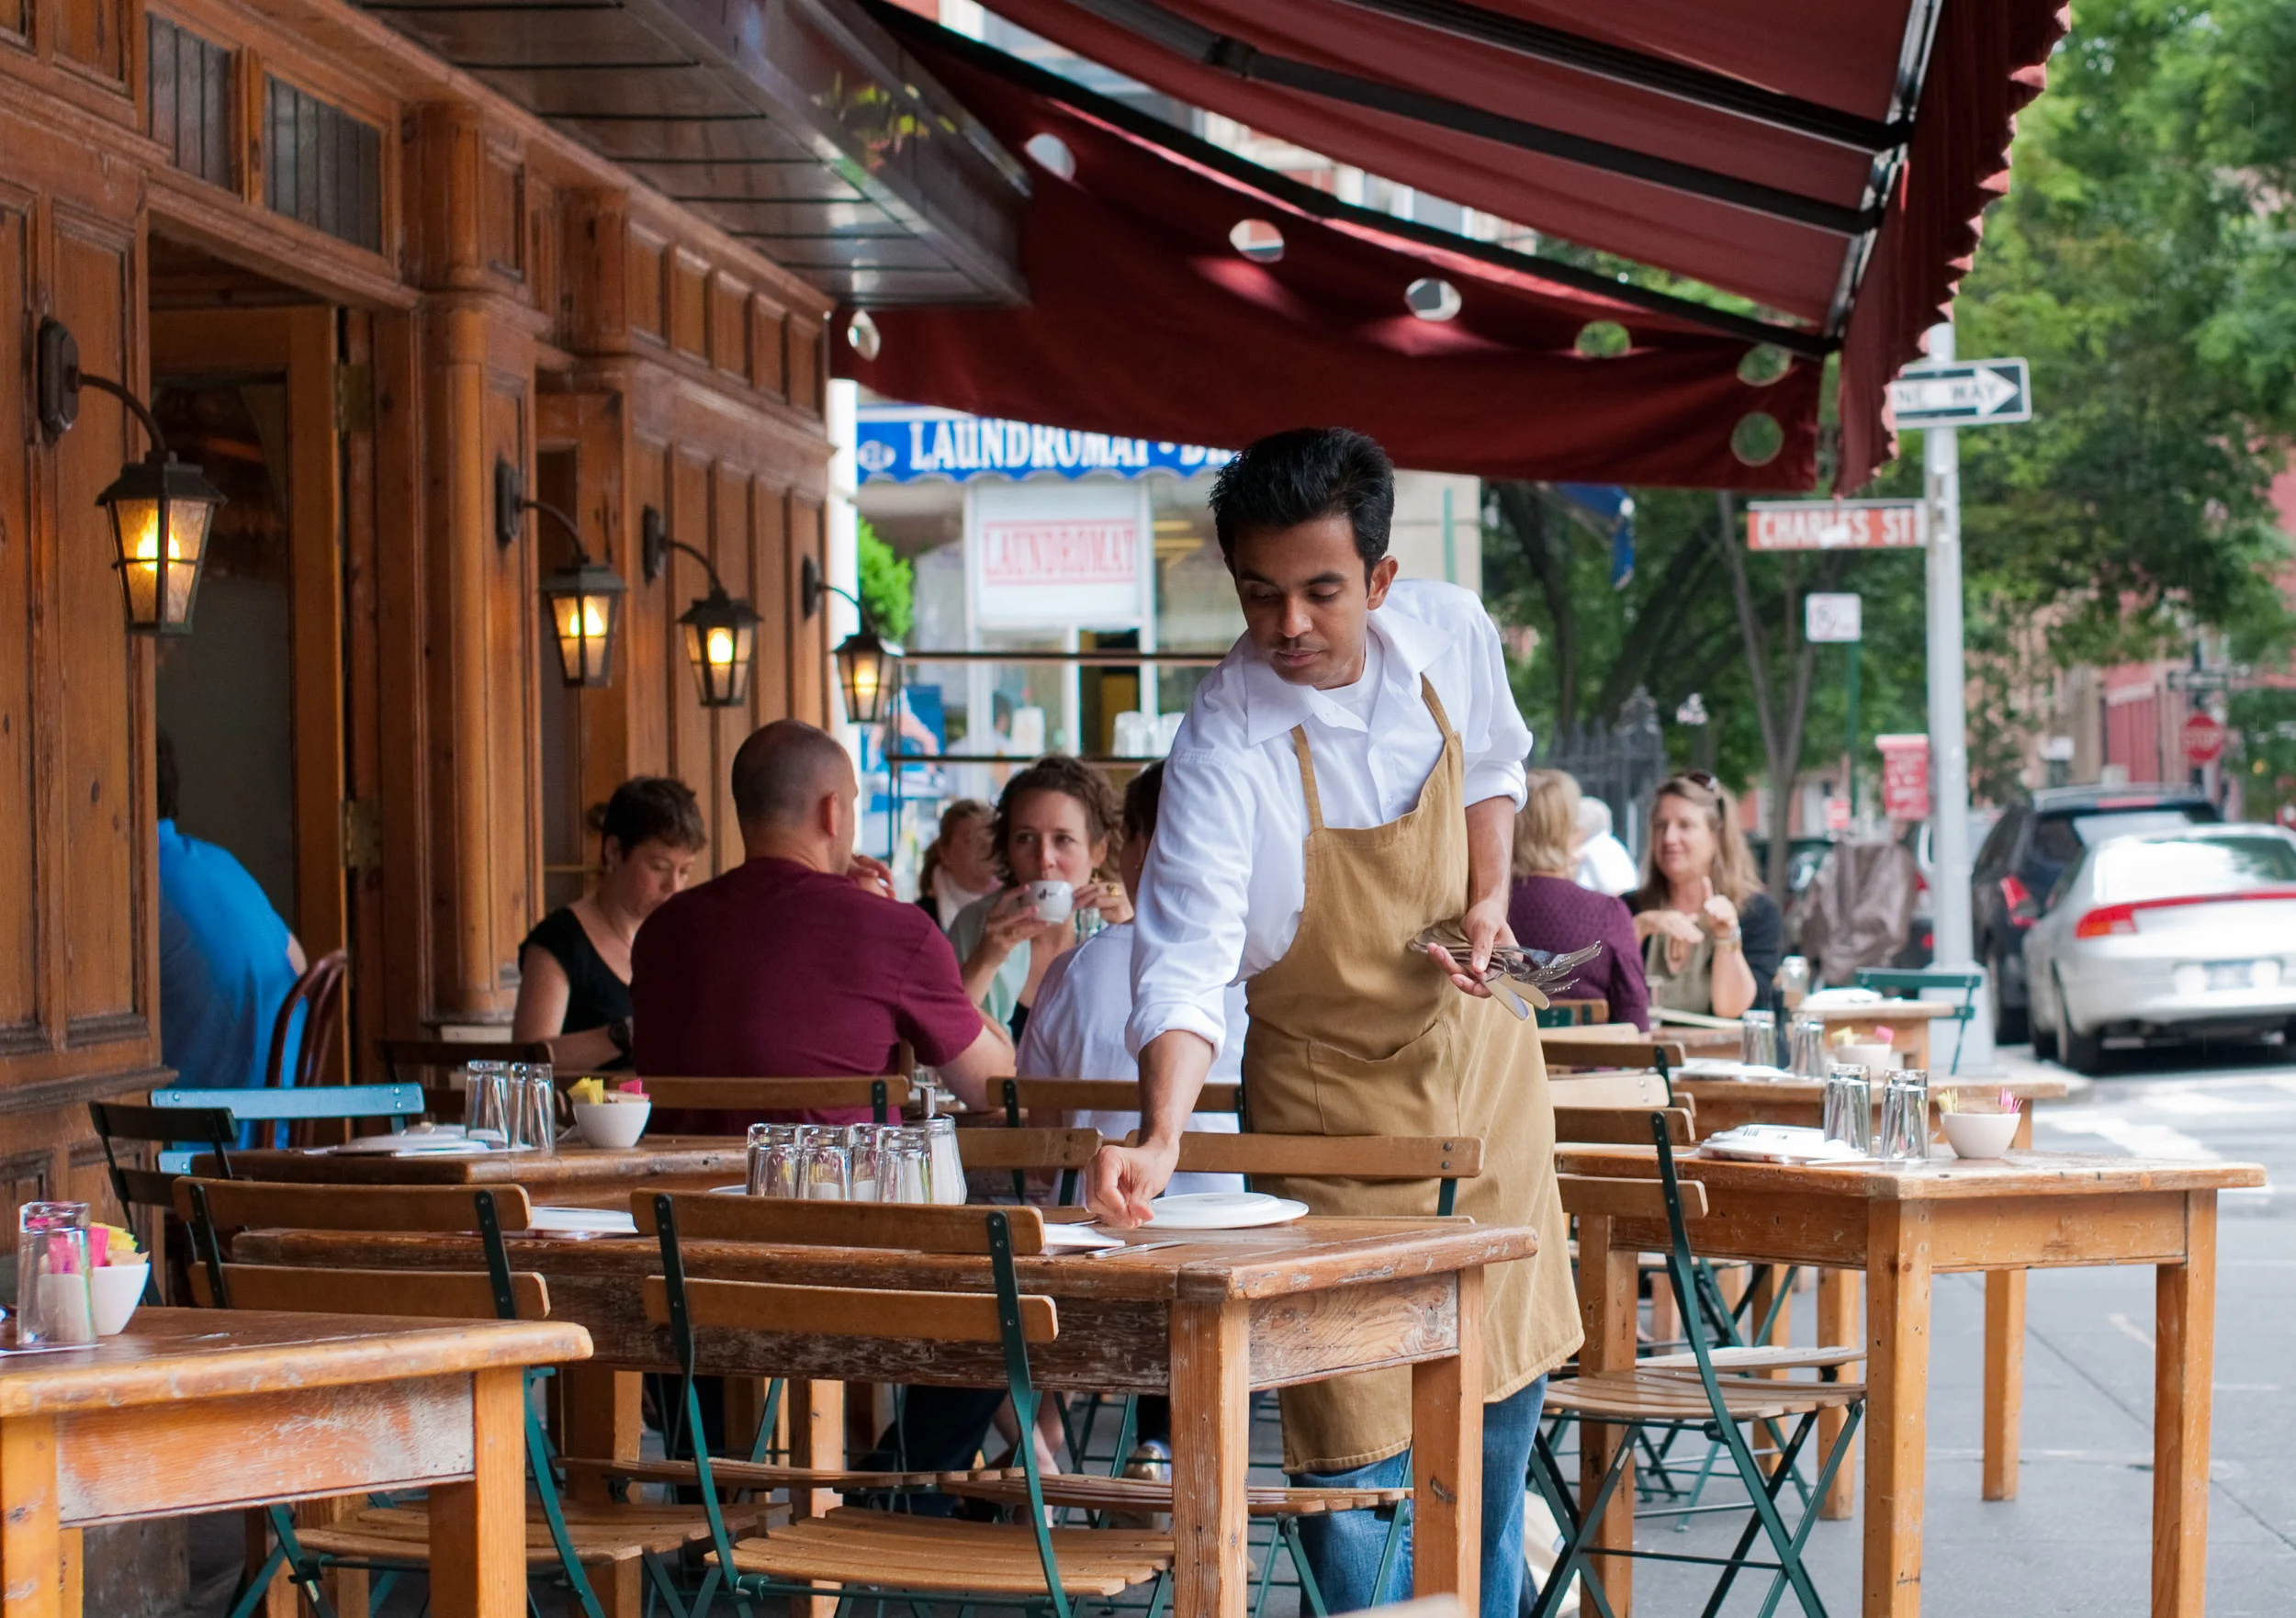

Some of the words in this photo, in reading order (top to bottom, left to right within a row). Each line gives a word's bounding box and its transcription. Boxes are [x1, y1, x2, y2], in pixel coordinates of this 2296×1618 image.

[1952, 382, 1998, 402] WAY
[1883, 508, 1913, 545] ST
[984, 529, 1135, 575] LAUNDROMAT
